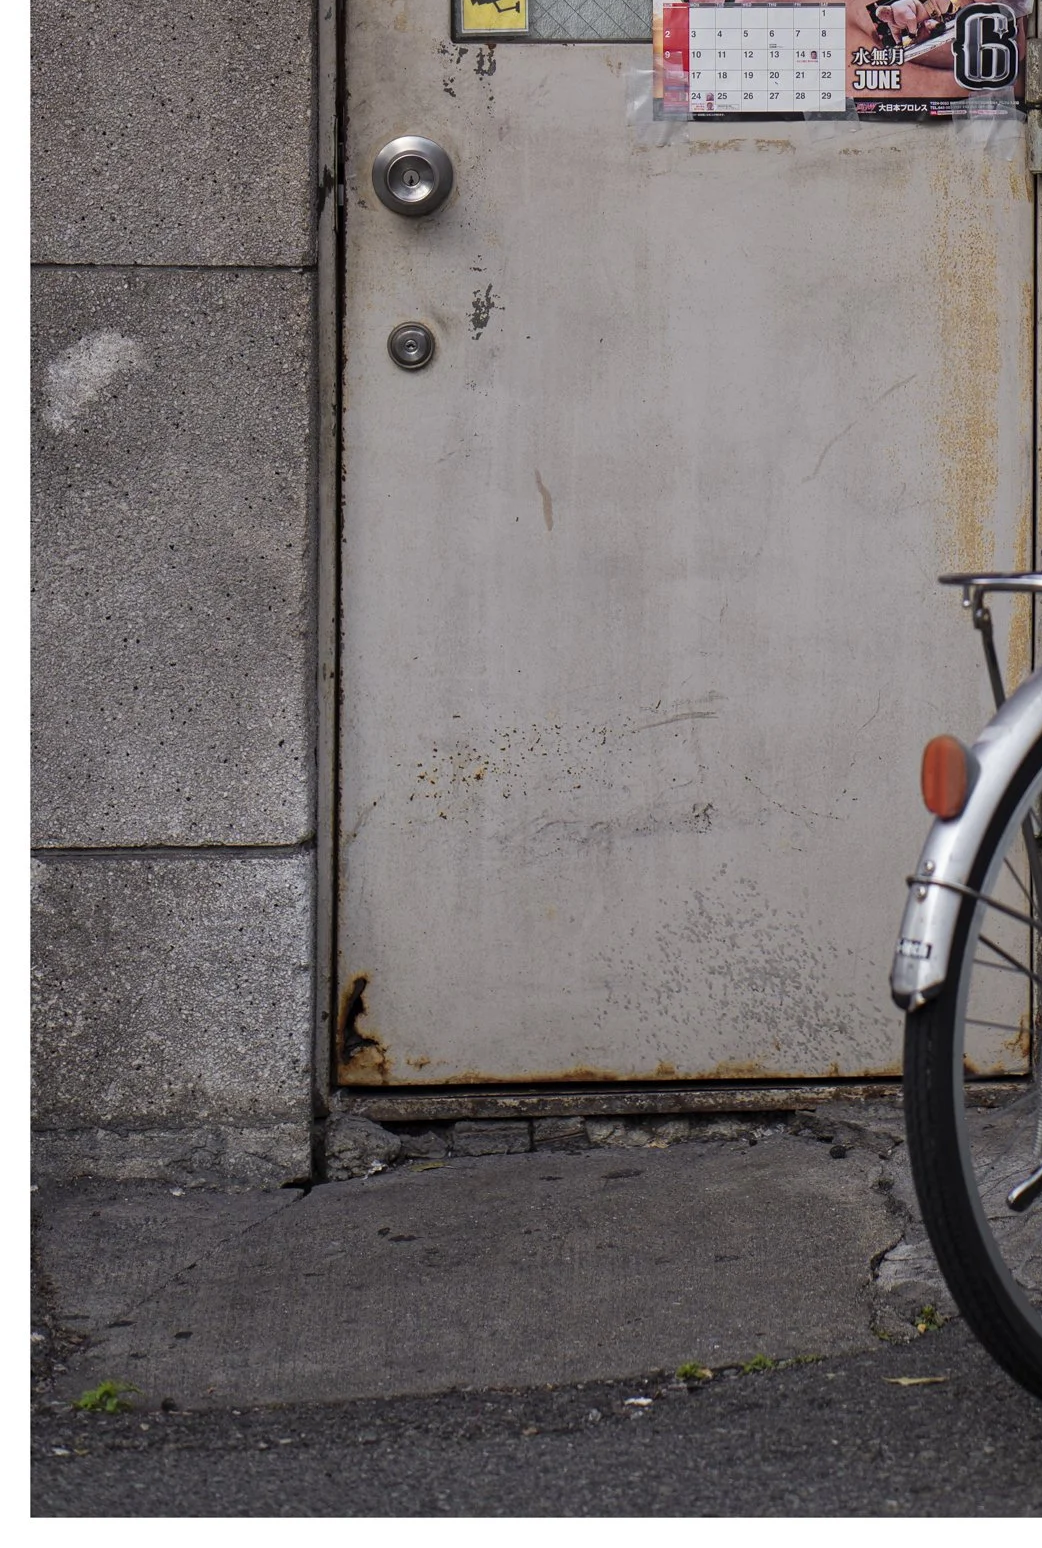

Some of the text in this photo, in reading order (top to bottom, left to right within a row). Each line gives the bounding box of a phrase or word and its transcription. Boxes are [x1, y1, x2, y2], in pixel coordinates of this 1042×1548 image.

[691, 51, 701, 59] 10
[717, 51, 725, 59] 11
[955, 5, 1014, 88] 6
[853, 47, 905, 66] 水無月
[853, 69, 901, 90] JUNE
[878, 103, 928, 112] 大日本プロレス
